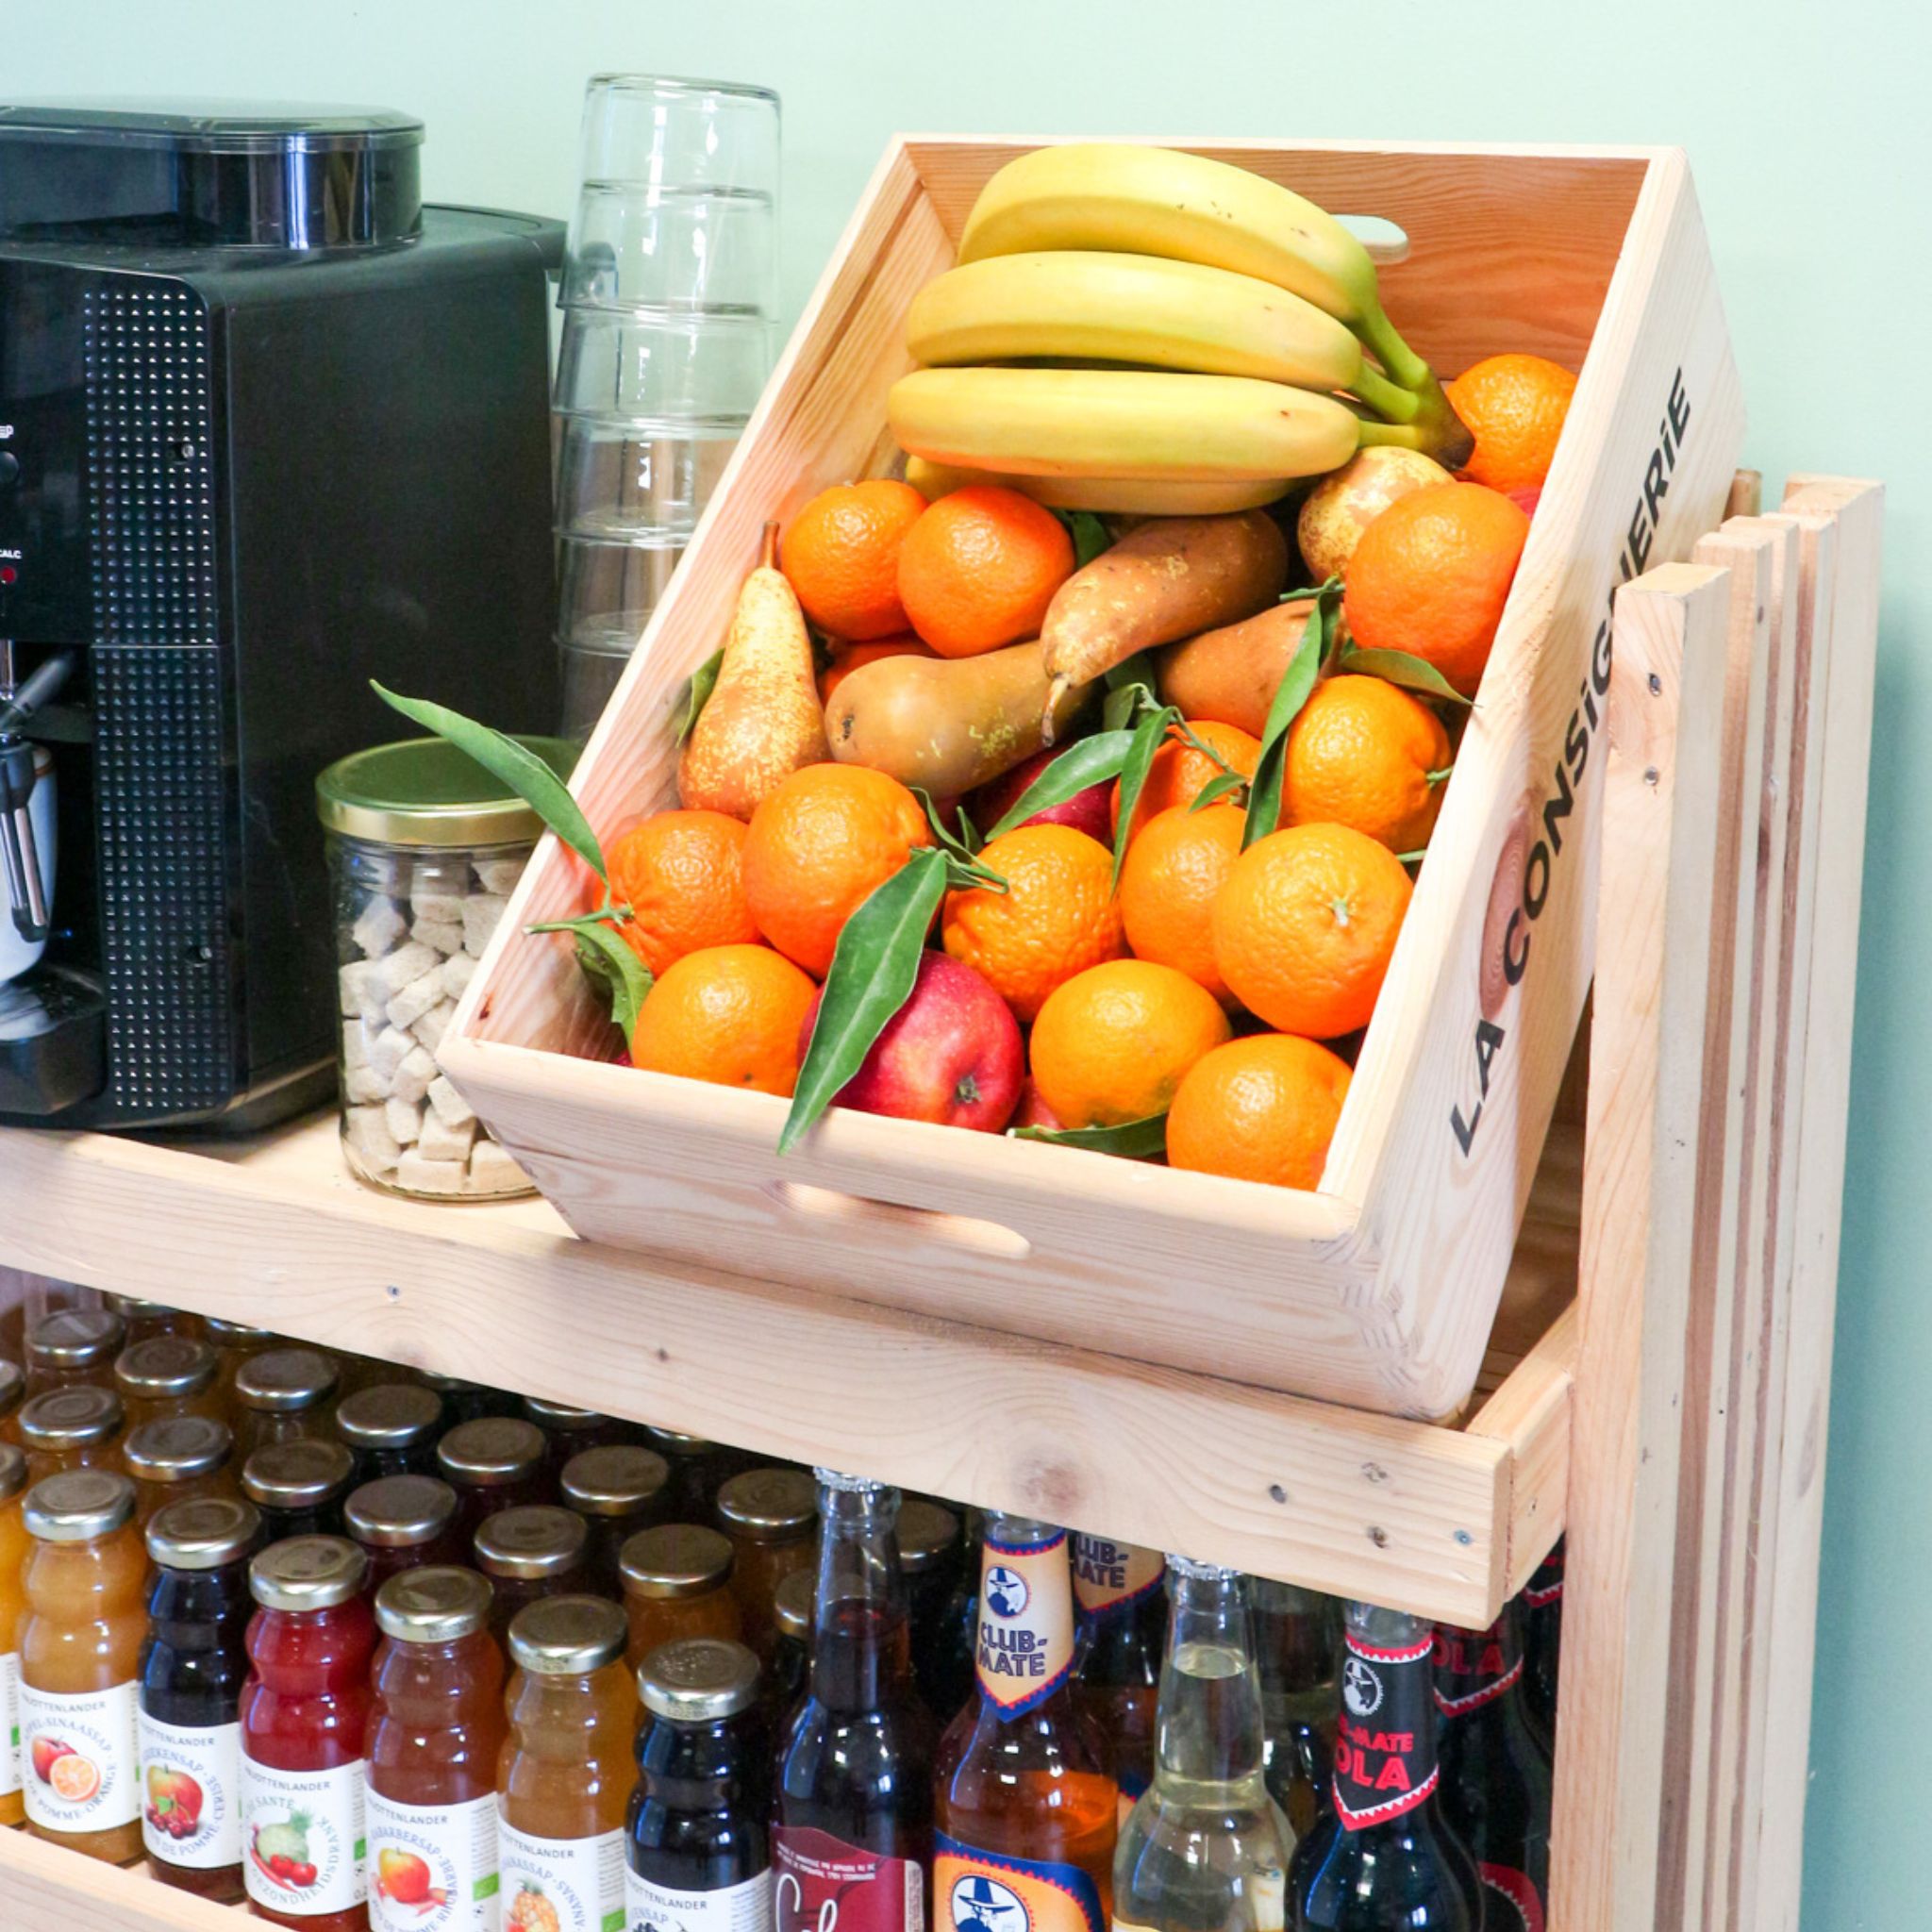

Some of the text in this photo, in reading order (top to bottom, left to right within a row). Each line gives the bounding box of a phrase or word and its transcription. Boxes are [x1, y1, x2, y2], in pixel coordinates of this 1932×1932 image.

[1450, 1018, 1506, 1158] LA
[1075, 1535, 1129, 1564] LUB-
[978, 1643, 1046, 1676] MATE
[1431, 1632, 1507, 1676] OLA
[1335, 1736, 1413, 1791] OLA
